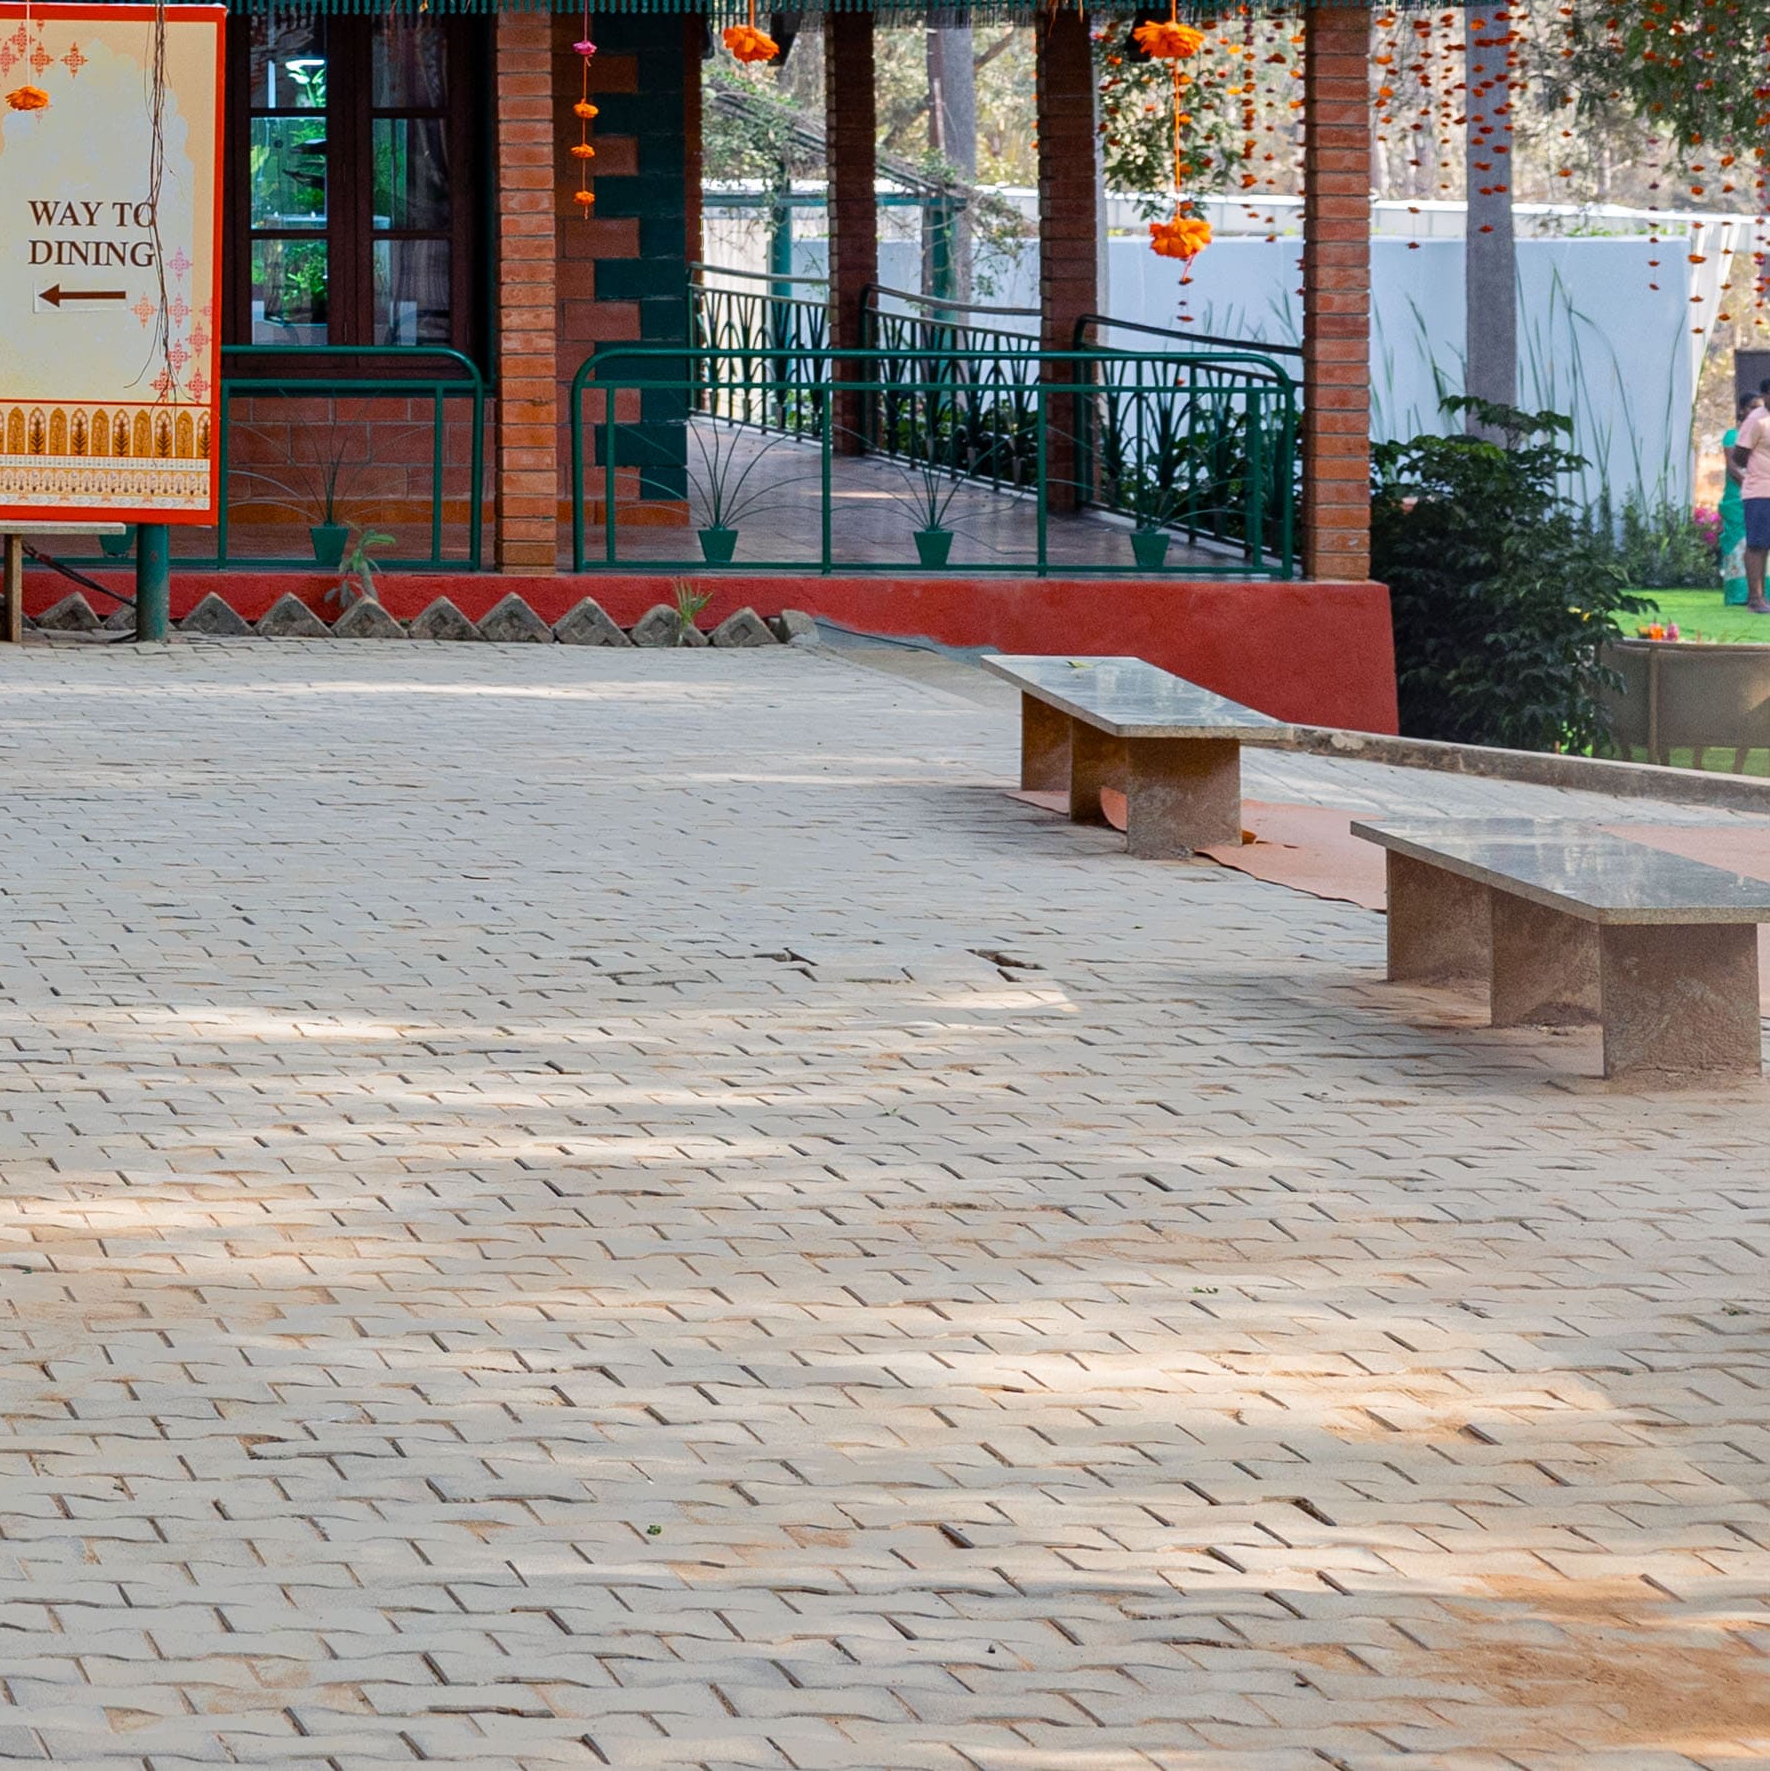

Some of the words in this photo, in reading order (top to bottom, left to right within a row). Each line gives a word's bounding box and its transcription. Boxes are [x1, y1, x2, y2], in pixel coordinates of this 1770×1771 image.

[27, 200, 104, 226] WAY
[111, 201, 156, 228] TO
[27, 239, 156, 267] DINING
